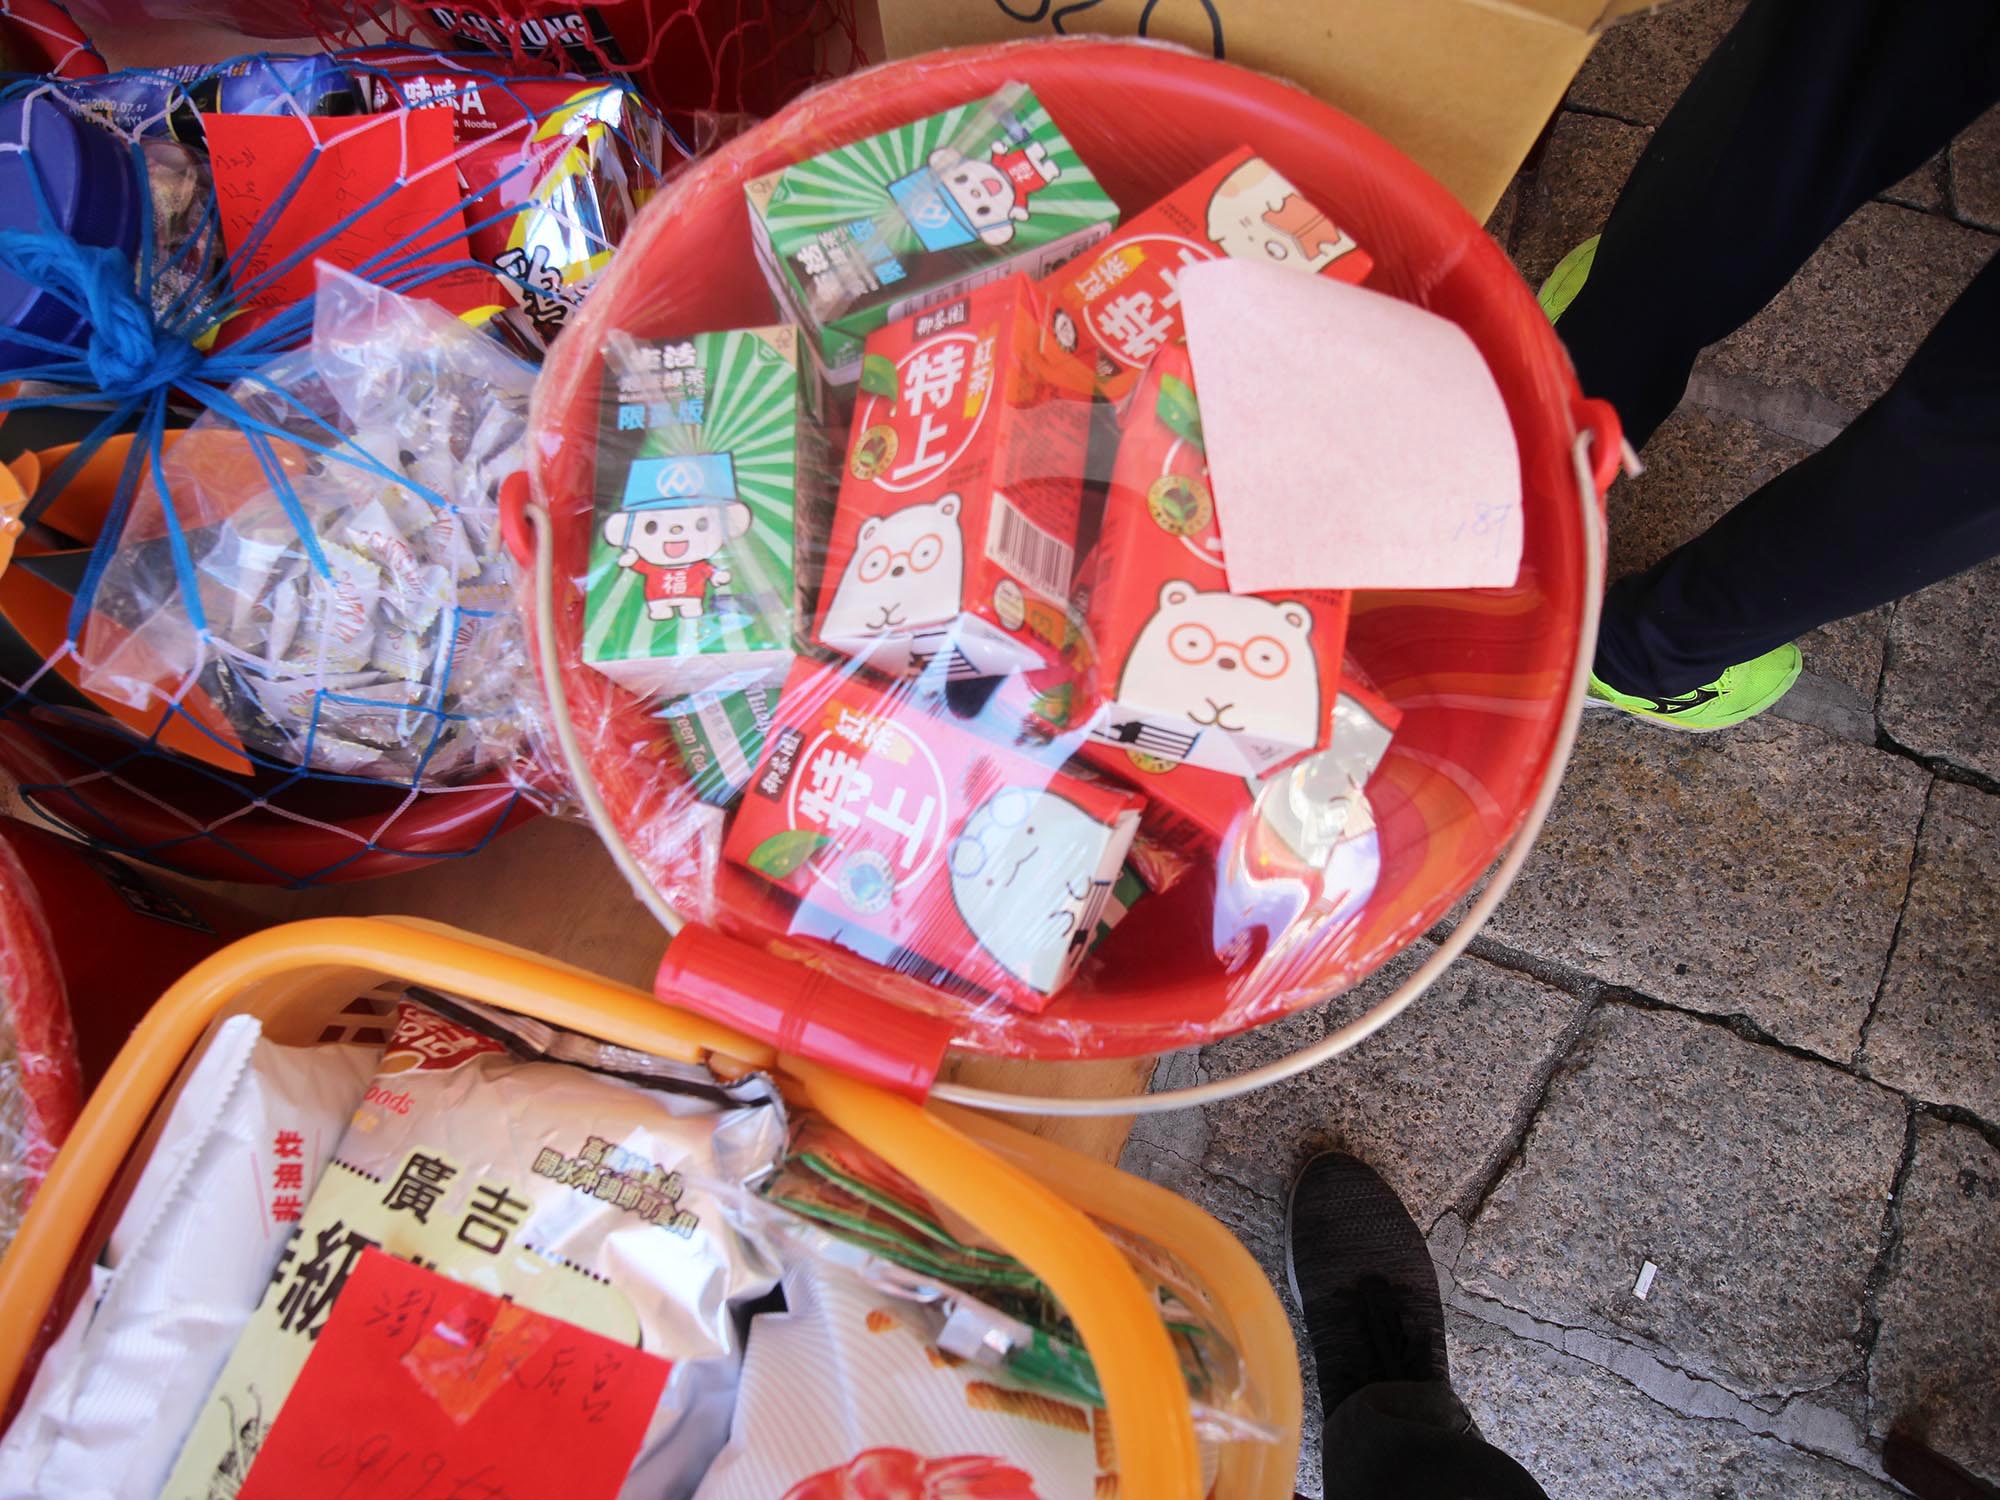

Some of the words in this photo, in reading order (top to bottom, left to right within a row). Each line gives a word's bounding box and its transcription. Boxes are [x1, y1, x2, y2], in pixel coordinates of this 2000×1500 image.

[464, 119, 498, 129] Noodles
[967, 335, 996, 397] 紅茶
[891, 345, 965, 481] 特上
[661, 570, 688, 595] 福
[688, 743, 709, 773] Tea
[797, 747, 936, 870] 特上
[363, 1085, 416, 1116] oods
[272, 1130, 304, 1223] 非油炸
[382, 1152, 529, 1255] 廣吉
